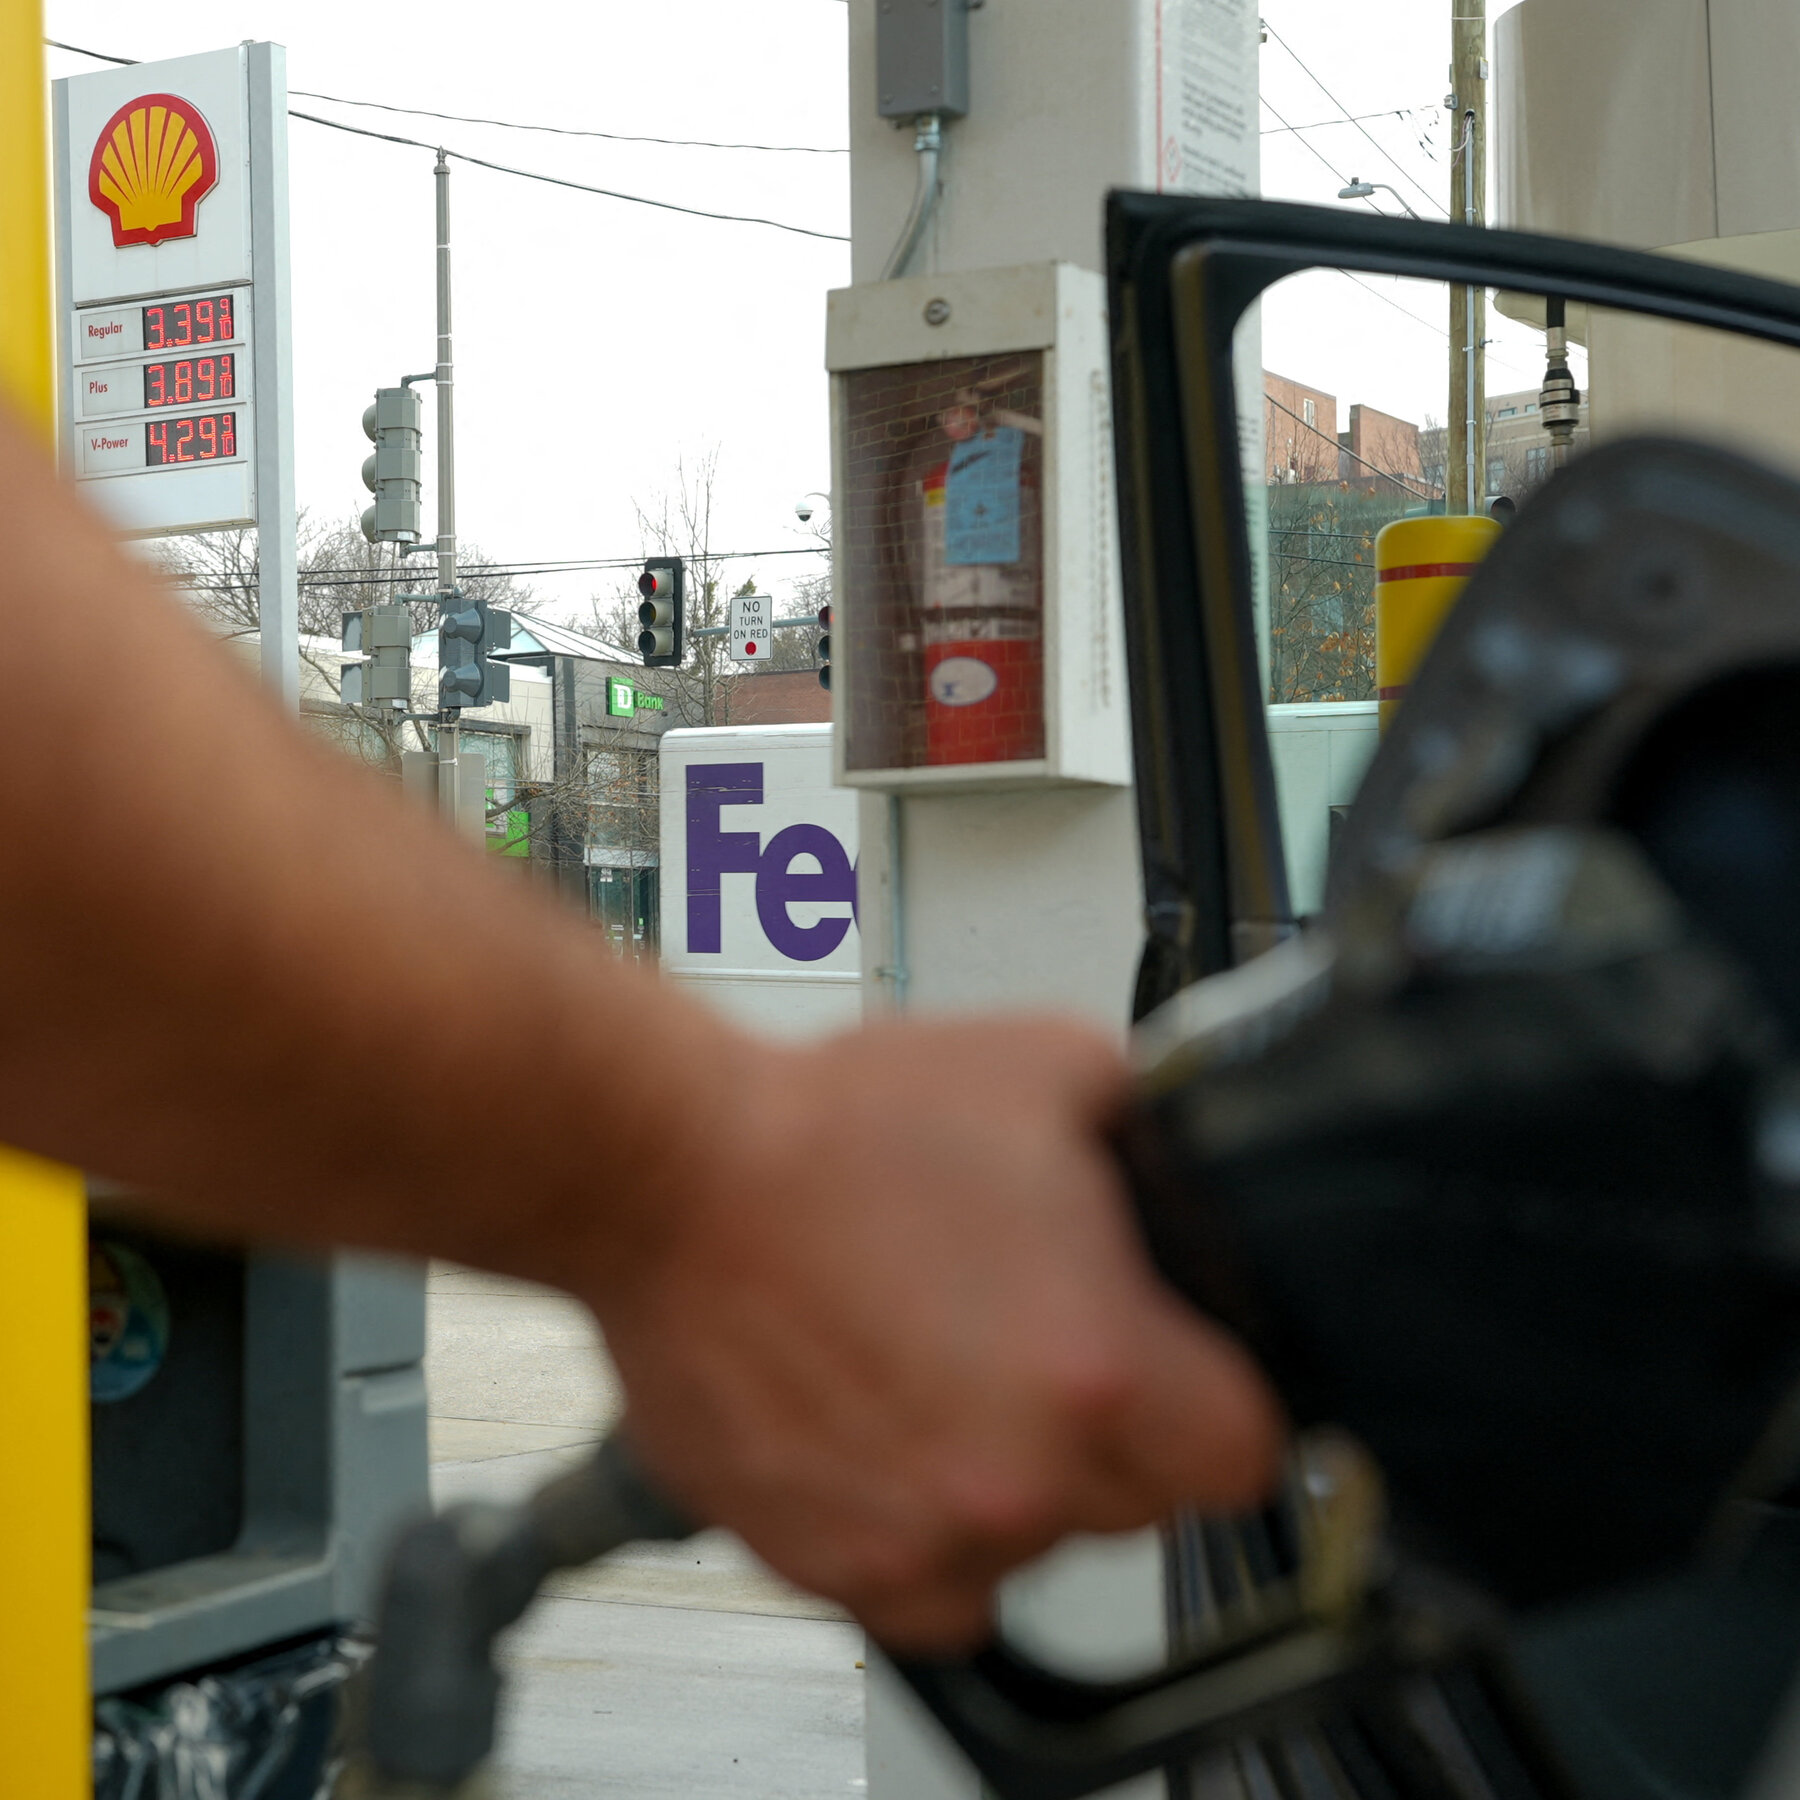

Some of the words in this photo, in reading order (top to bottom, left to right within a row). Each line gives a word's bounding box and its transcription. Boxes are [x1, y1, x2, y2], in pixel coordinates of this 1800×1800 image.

[88, 322, 123, 339] Regular
[89, 381, 108, 394] Plus
[91, 438, 129, 450] V-Power
[742, 601, 760, 613] NO
[740, 616, 763, 626] TURN
[733, 630, 746, 639] ON
[750, 628, 768, 639] RED
[613, 683, 632, 709] TD
[636, 690, 664, 710] Bank
[685, 762, 860, 962] Fe
